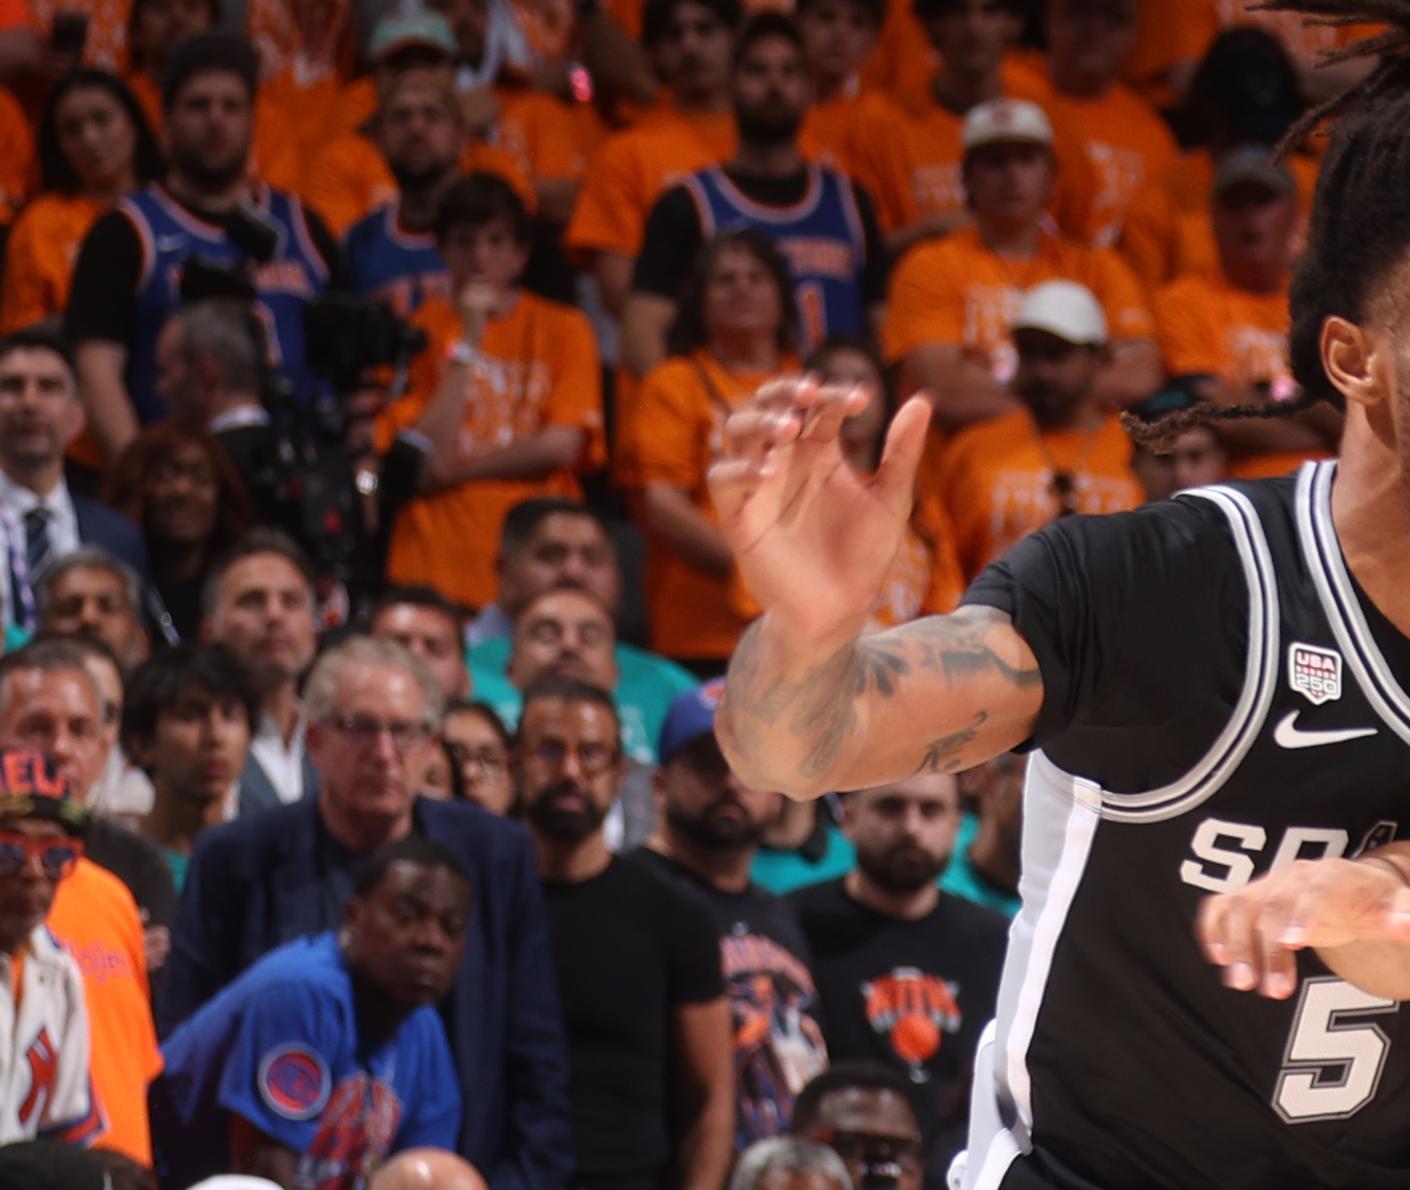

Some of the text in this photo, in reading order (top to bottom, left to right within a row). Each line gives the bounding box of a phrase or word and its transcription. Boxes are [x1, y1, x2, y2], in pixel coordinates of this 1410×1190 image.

[1296, 651, 1335, 672] USA
[1296, 673, 1338, 694] 250
[1271, 976, 1400, 1125] 5
